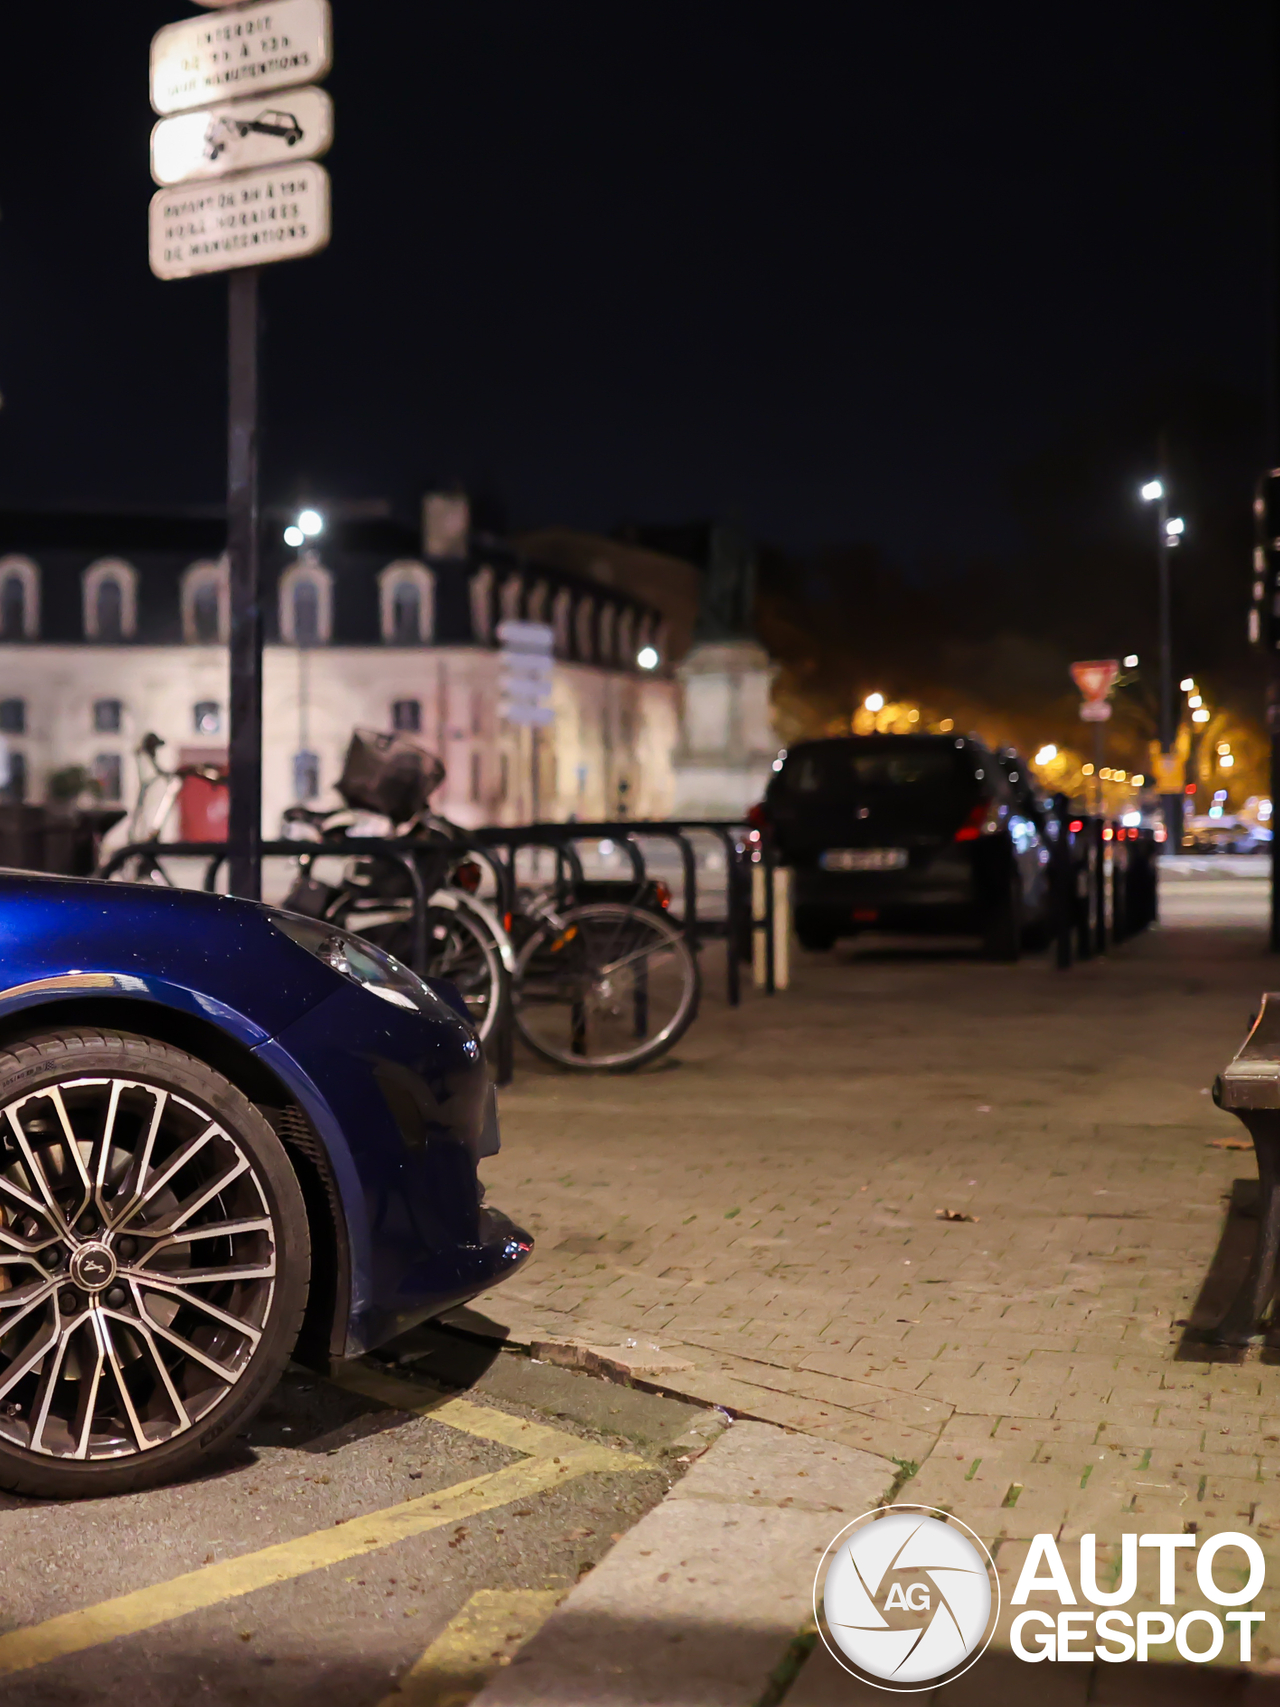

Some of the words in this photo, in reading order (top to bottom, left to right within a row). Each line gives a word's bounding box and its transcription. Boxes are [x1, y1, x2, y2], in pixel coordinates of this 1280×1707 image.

[197, 15, 271, 48] INTERDIT
[204, 51, 311, 86] MANUTENTIONS
[190, 224, 310, 255] MANUTENTIONS
